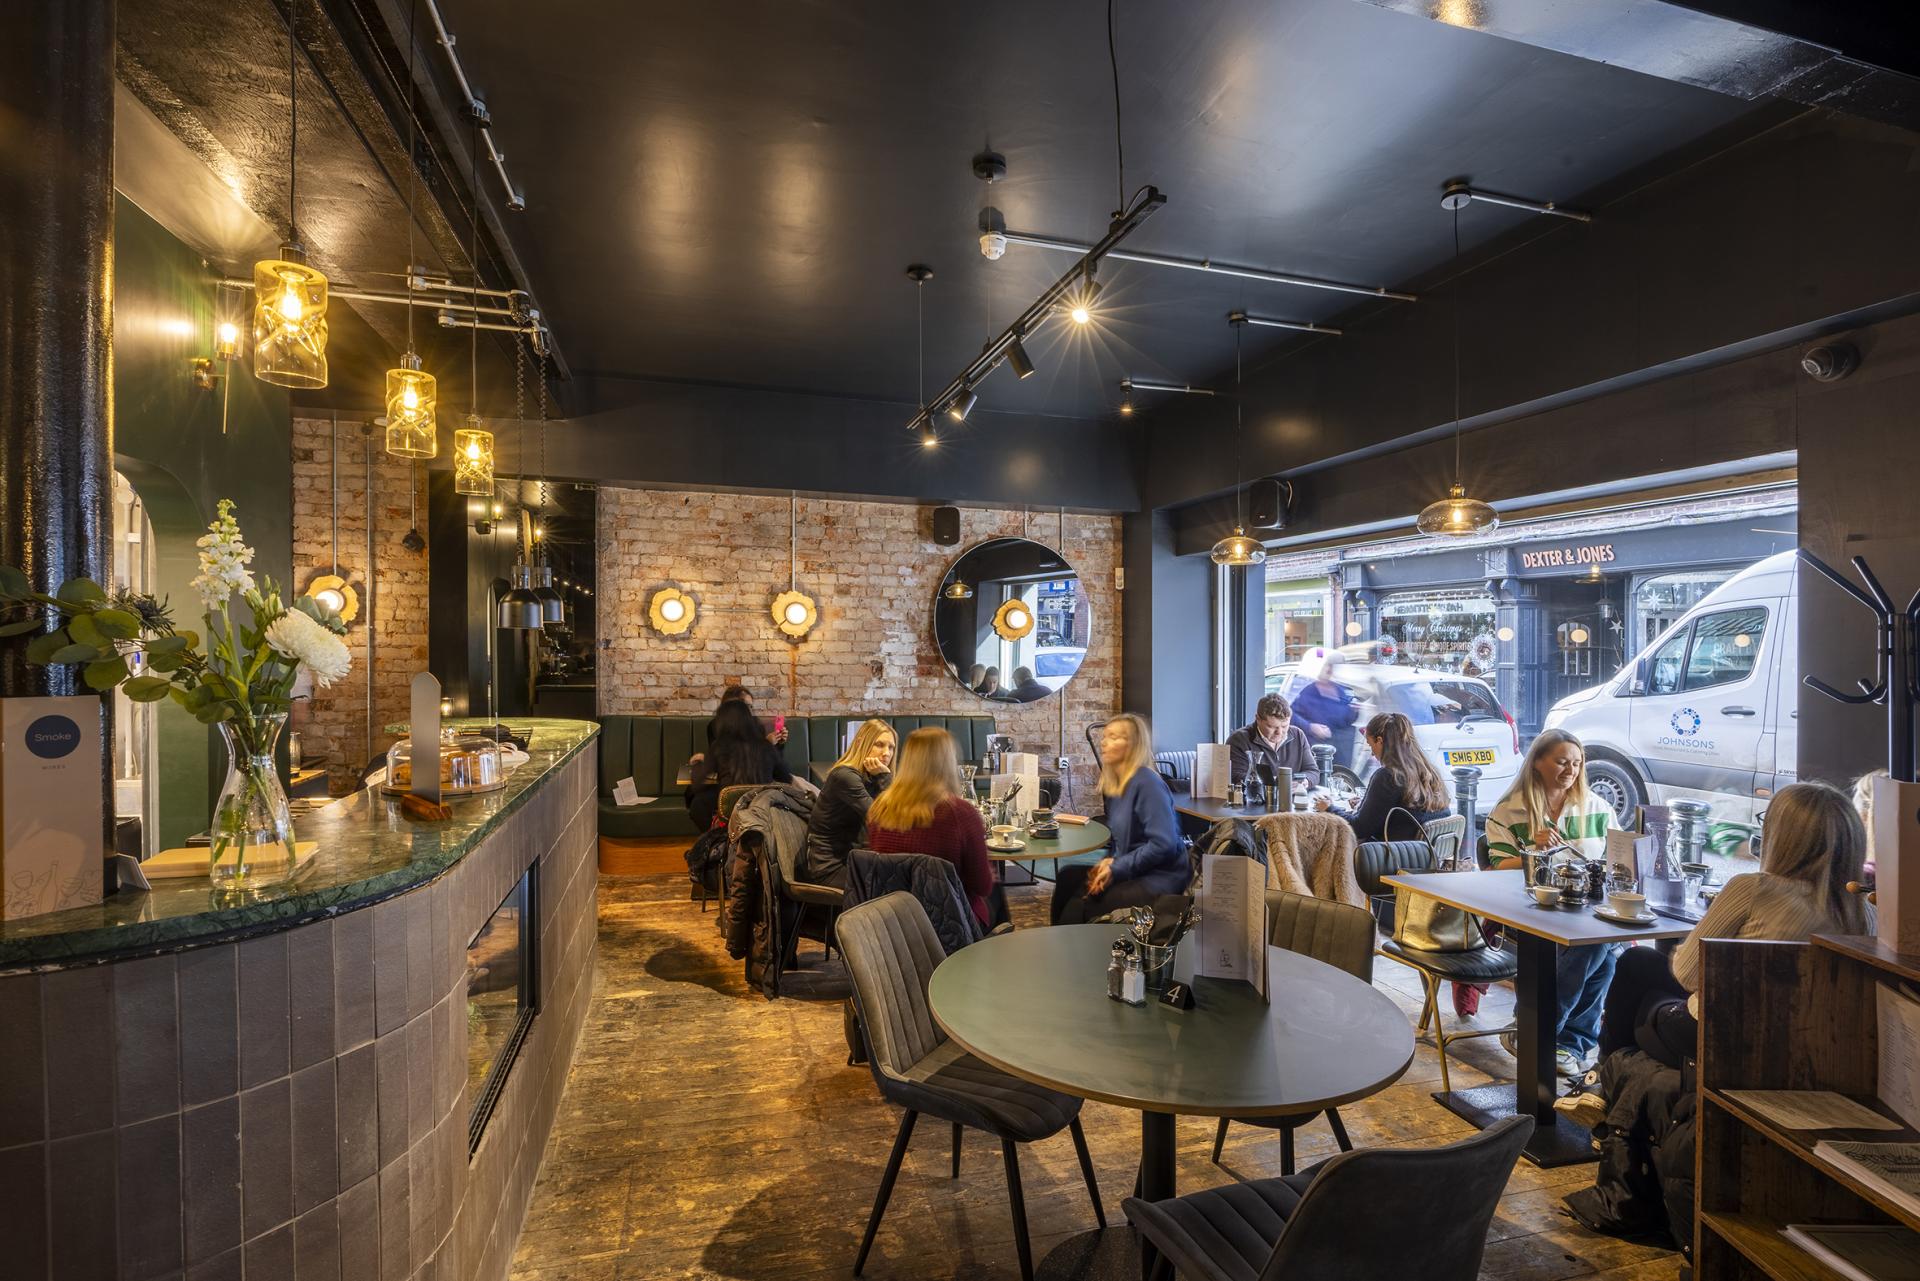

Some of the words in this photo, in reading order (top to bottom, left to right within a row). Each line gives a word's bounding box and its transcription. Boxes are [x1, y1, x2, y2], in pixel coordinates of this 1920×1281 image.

[1523, 550, 1564, 568] DEXTER
[1565, 549, 1575, 565] &
[1576, 545, 1615, 564] JONES
[34, 732, 72, 742] Smoke
[1657, 736, 1715, 749] JOHNSONS
[1452, 751, 1472, 763] SM16
[1167, 985, 1181, 1003] 4
